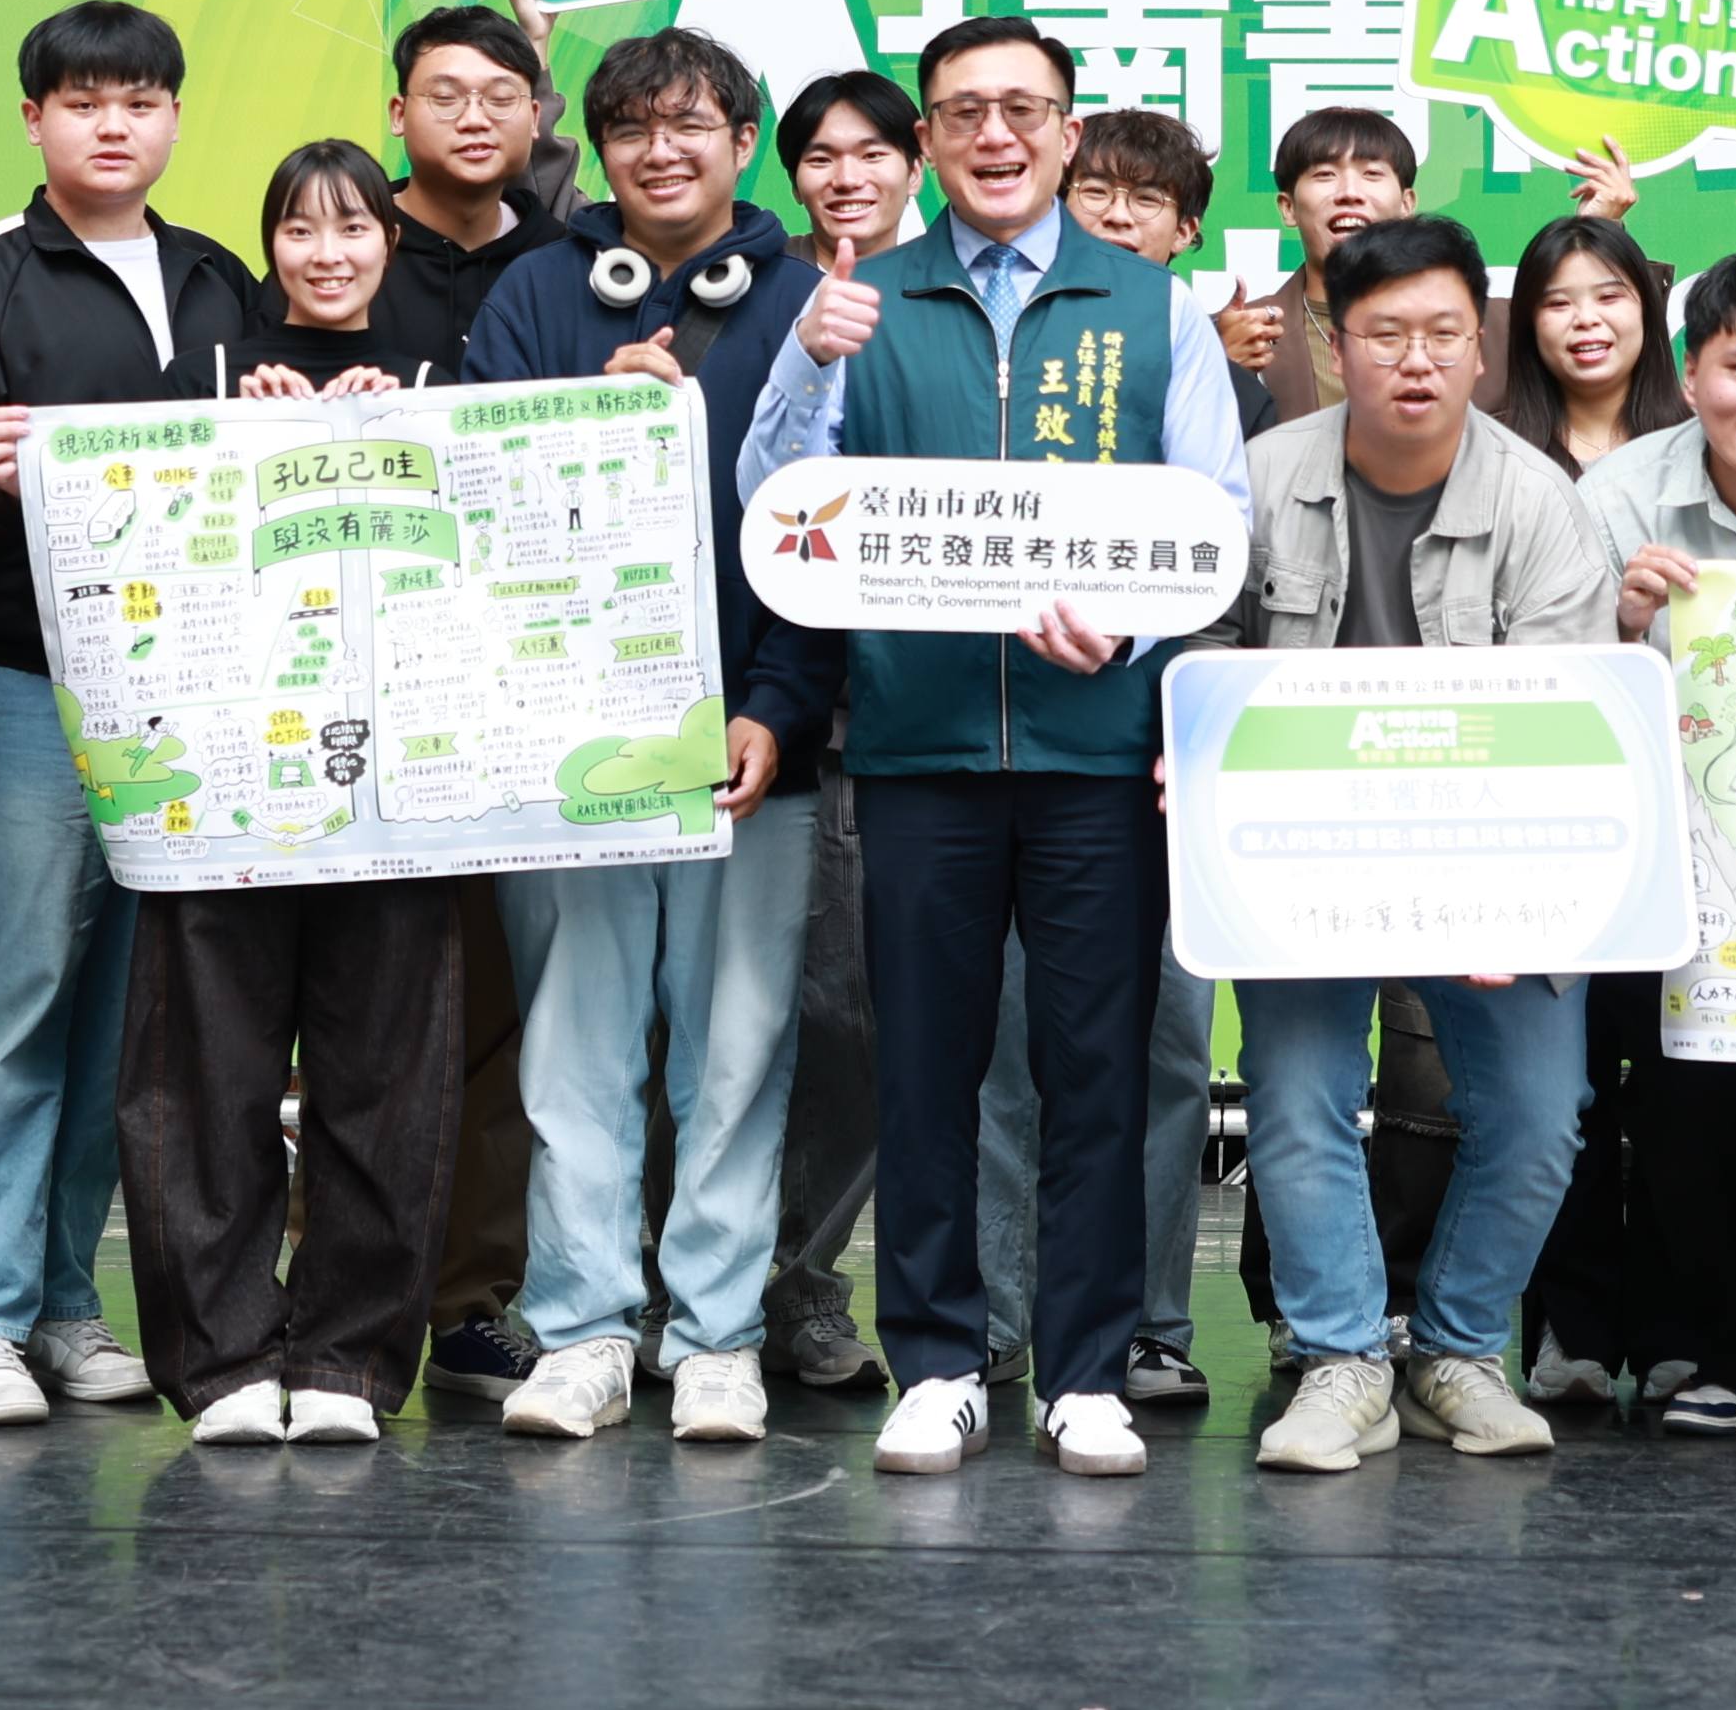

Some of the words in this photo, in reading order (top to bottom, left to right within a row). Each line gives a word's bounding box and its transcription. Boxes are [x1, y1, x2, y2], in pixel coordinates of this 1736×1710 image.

[1034, 359, 1075, 464] 王效
[272, 450, 423, 486] 孔乙己哇
[857, 486, 1044, 523] 臺南市政府
[272, 510, 432, 557] 與沒有麗莎
[857, 531, 1222, 575] 研究發展考核委員會
[858, 574, 928, 590] Research,
[930, 575, 1021, 594] Development
[1024, 577, 1049, 592] and
[1052, 578, 1125, 595] Evaluation
[1127, 580, 1219, 599] Commission,
[858, 593, 903, 607] Tainan
[905, 593, 934, 610] City
[936, 595, 1022, 610] Government
